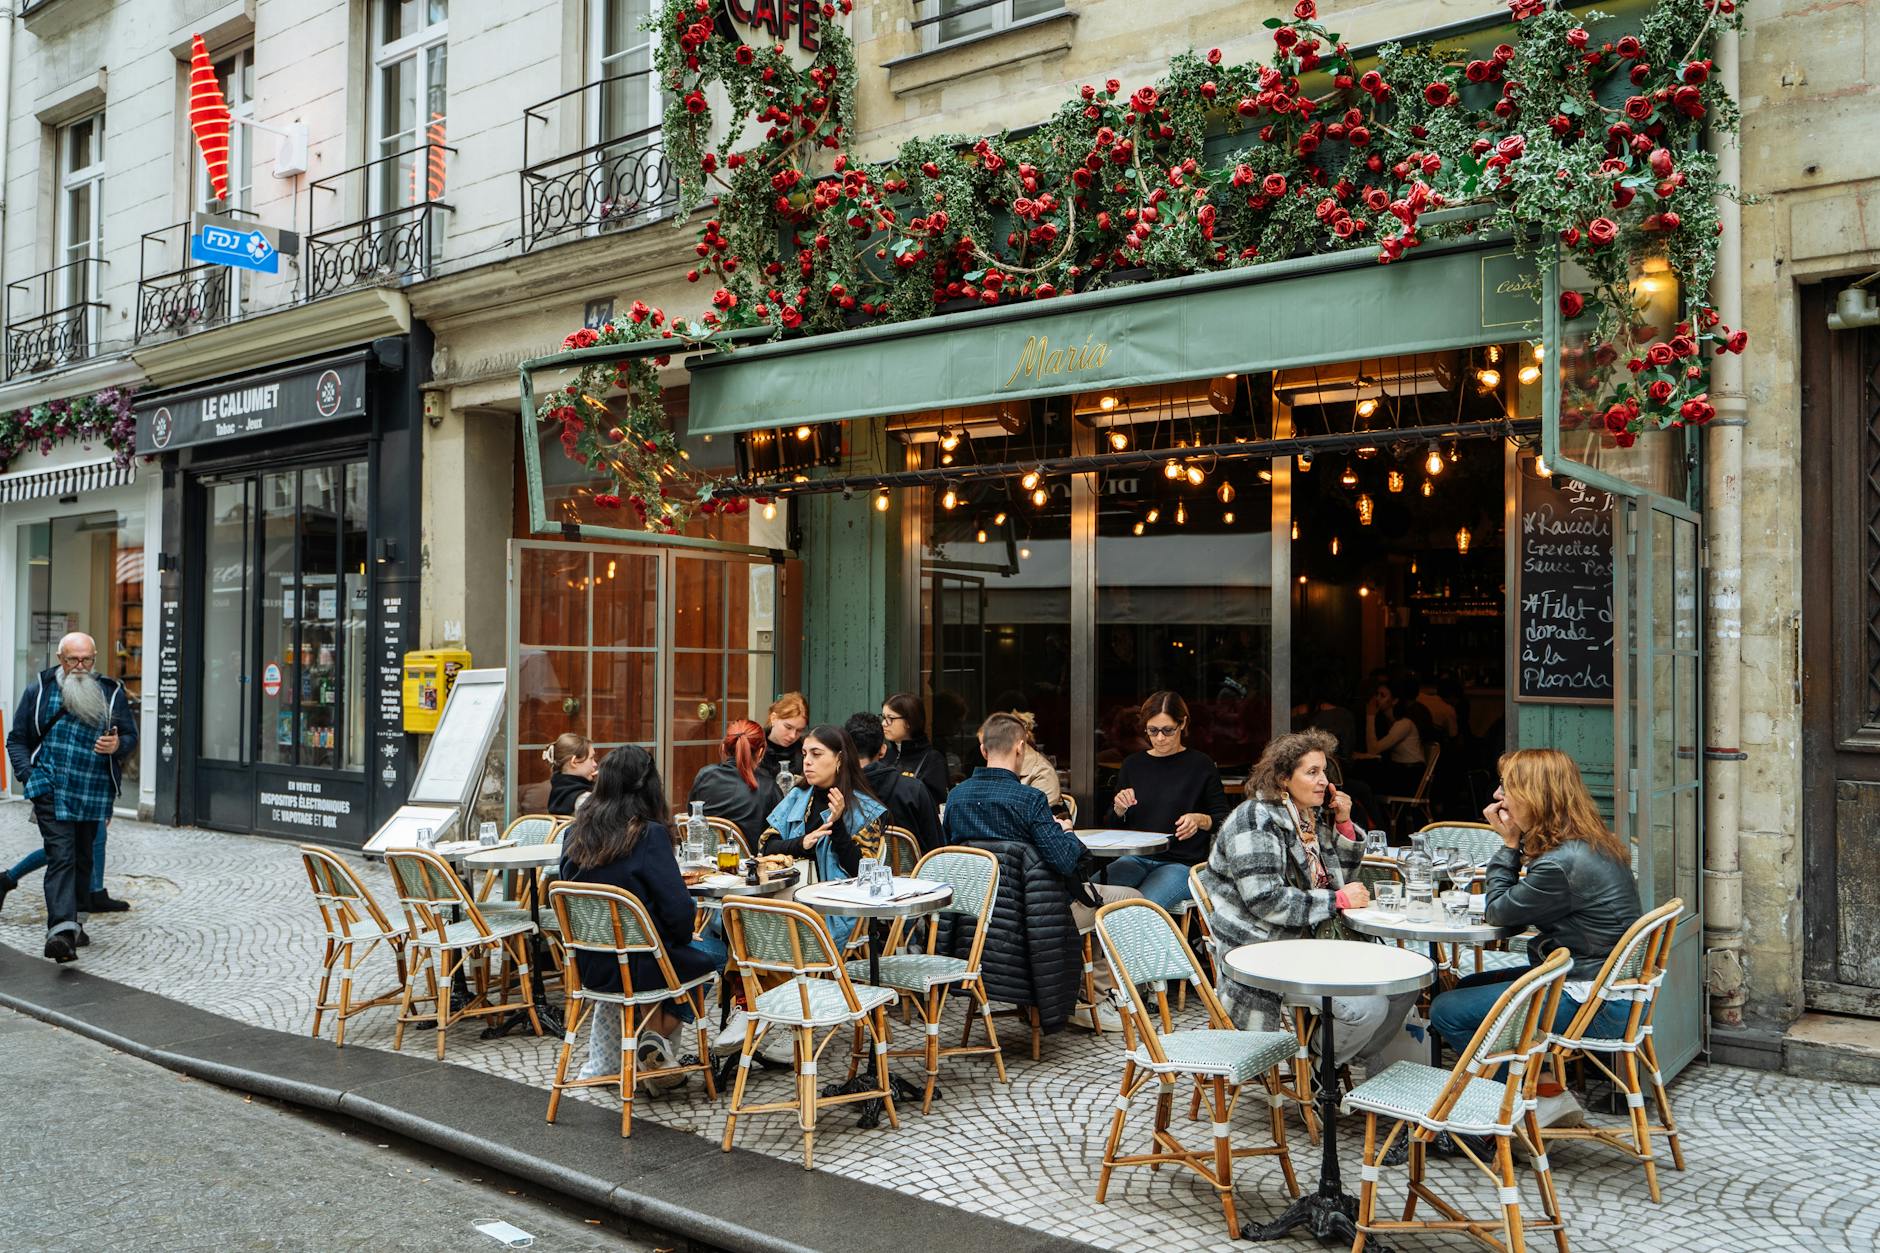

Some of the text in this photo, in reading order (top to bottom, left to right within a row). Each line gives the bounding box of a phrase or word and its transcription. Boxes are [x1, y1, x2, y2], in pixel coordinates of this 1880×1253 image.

[206, 230, 240, 249] FDJ
[588, 303, 610, 328] 47
[202, 383, 280, 421] LE CALUMET
[216, 423, 235, 437] Tabac
[245, 417, 263, 431] Jeux
[1541, 590, 1595, 621] Filet
[296, 782, 313, 793] VENTE
[312, 783, 321, 793] ICI
[261, 792, 351, 814] DISPOSITIFS ÉLECTRONIQUES
[272, 809, 337, 828] DE VAPOTAGE ET BOX
